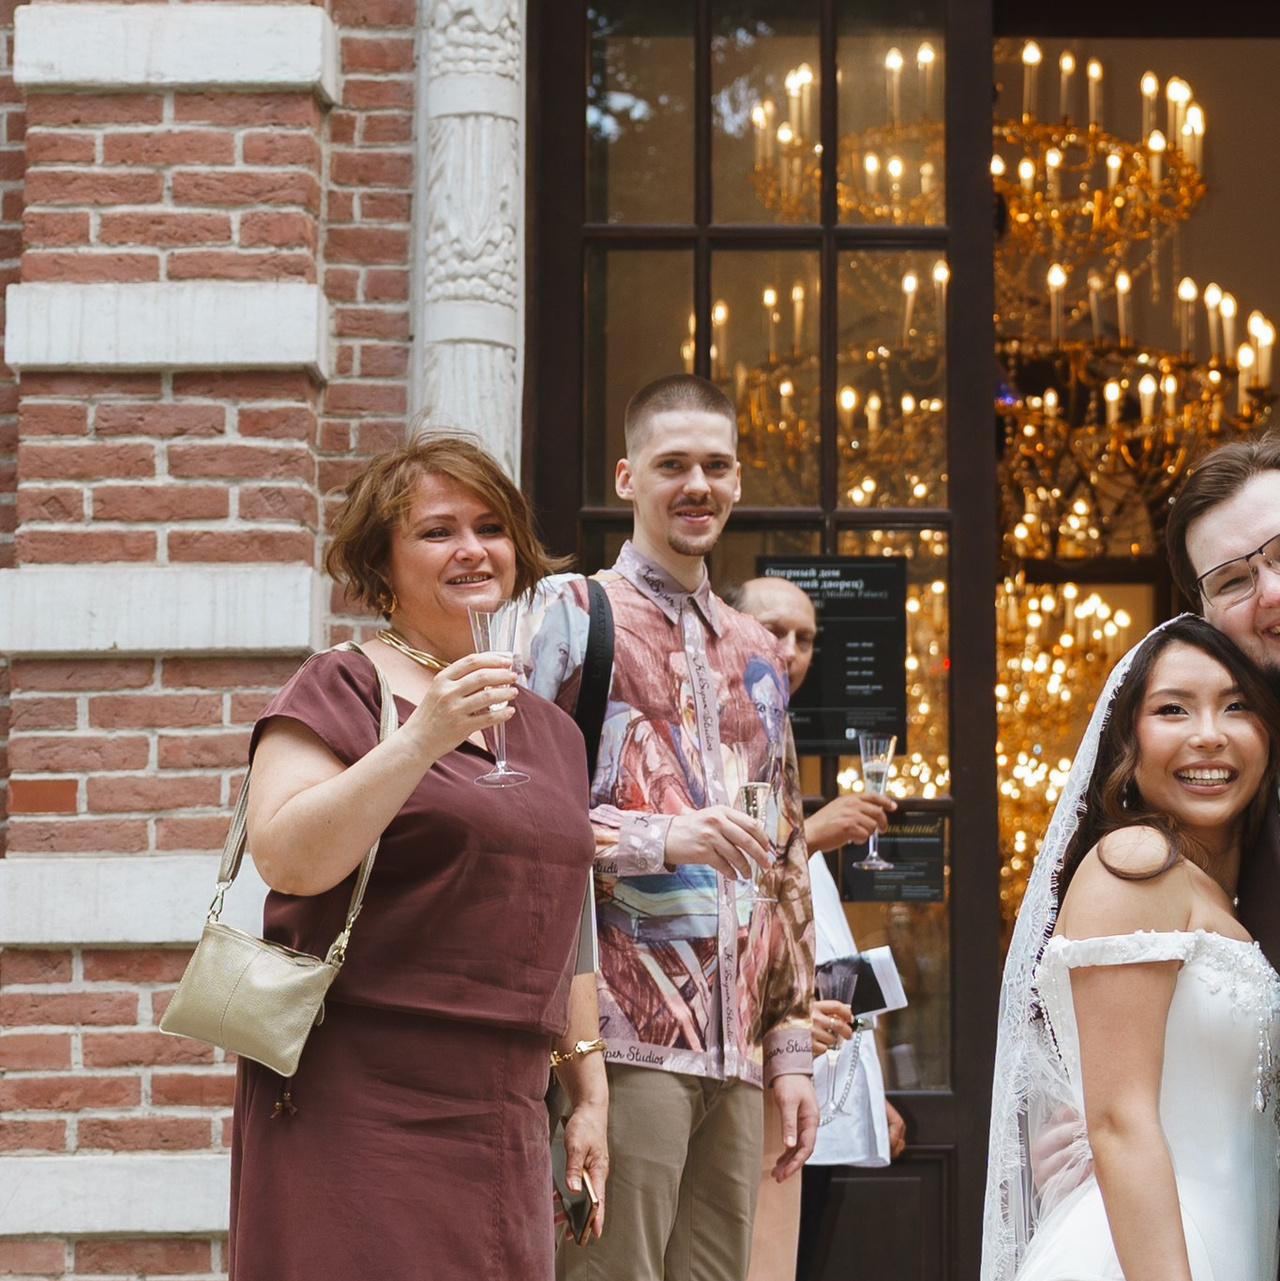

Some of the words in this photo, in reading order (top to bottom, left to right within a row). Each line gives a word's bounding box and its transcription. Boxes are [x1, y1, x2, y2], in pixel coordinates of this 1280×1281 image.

[765, 568, 816, 578] Оперный
[818, 570, 840, 578] дом
[627, 1046, 664, 1065] Studios
